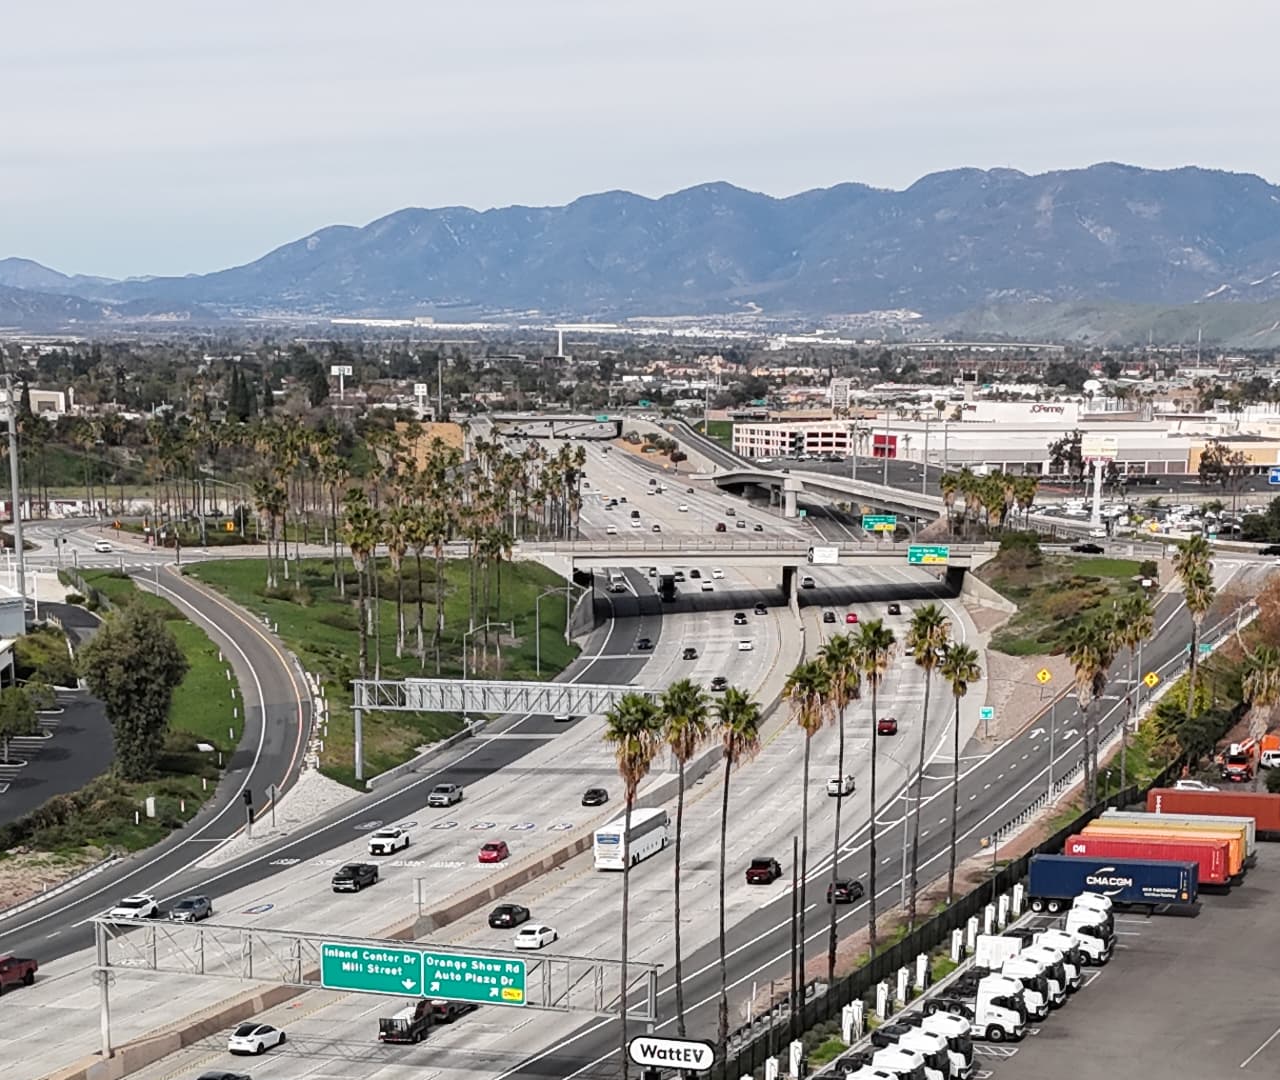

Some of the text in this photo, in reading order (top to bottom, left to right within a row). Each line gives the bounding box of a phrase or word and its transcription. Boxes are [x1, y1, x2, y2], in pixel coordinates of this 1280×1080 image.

[1086, 876, 1133, 887] CMA CGM
[324, 947, 416, 965] Inland Center Dr
[342, 961, 403, 976] Mill Street
[426, 956, 520, 974] Orange Show Rd
[434, 970, 514, 986] Auto Plaza Dr
[640, 1043, 705, 1063] WattEV
